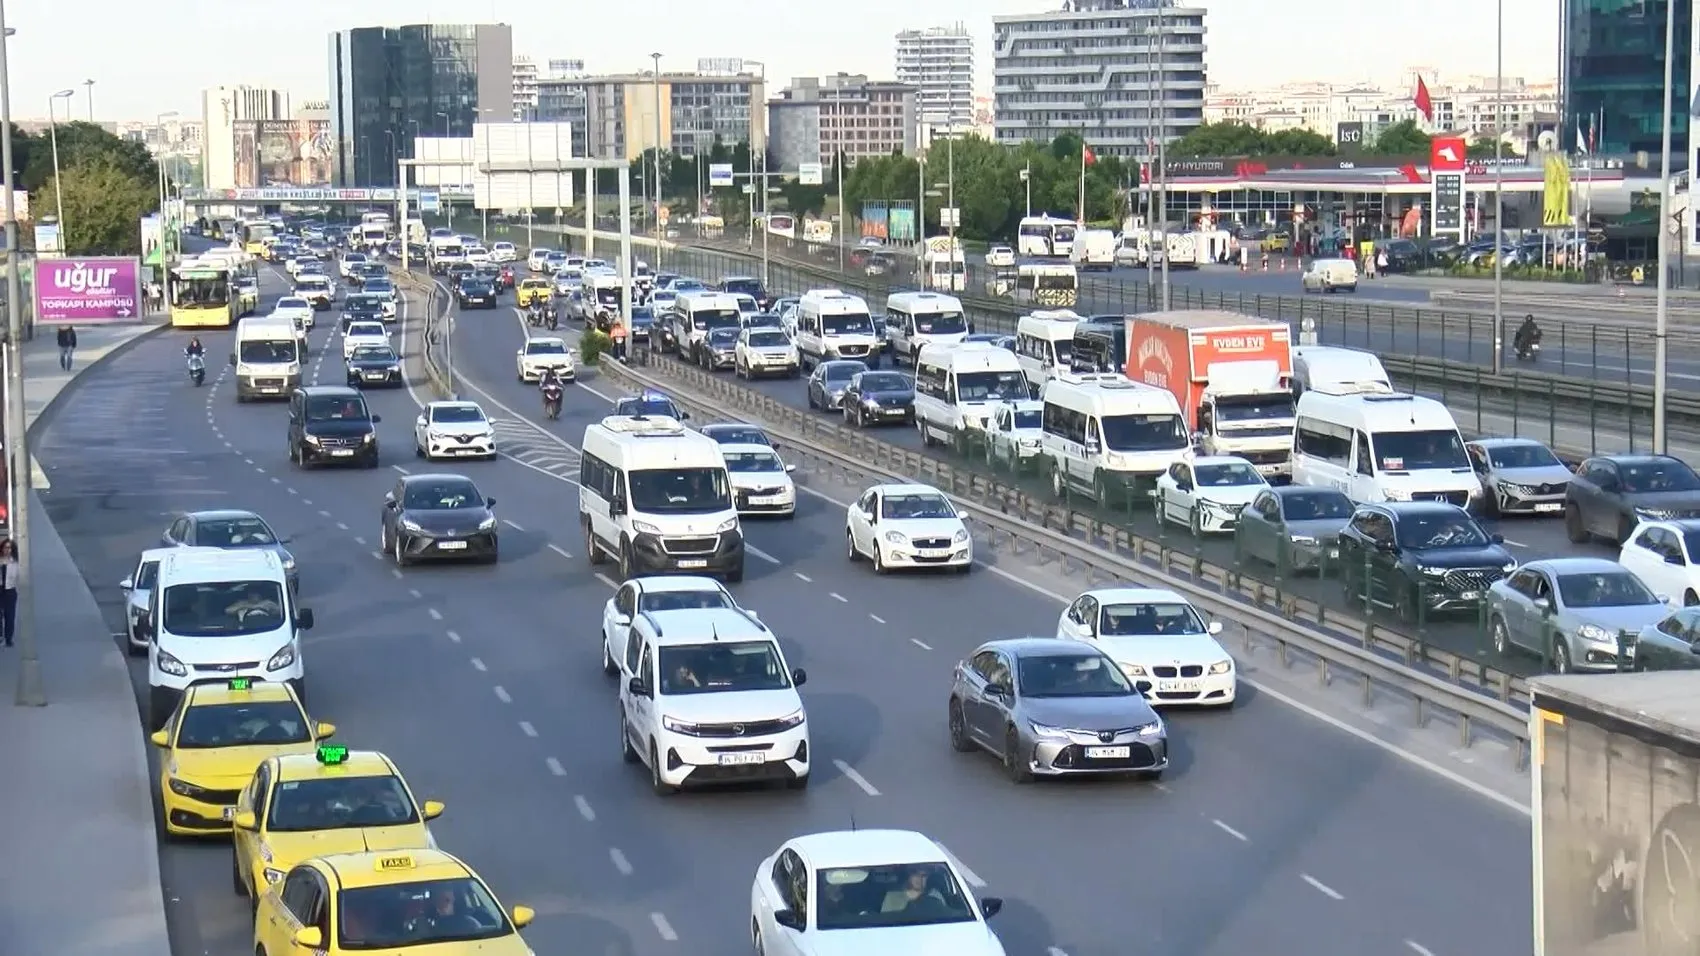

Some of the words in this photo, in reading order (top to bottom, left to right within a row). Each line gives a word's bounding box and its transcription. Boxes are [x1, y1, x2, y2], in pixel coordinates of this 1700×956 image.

[55, 262, 118, 293] uğur
[41, 300, 84, 309] TOPKAPI
[86, 298, 133, 308] KAMPÜSÜ
